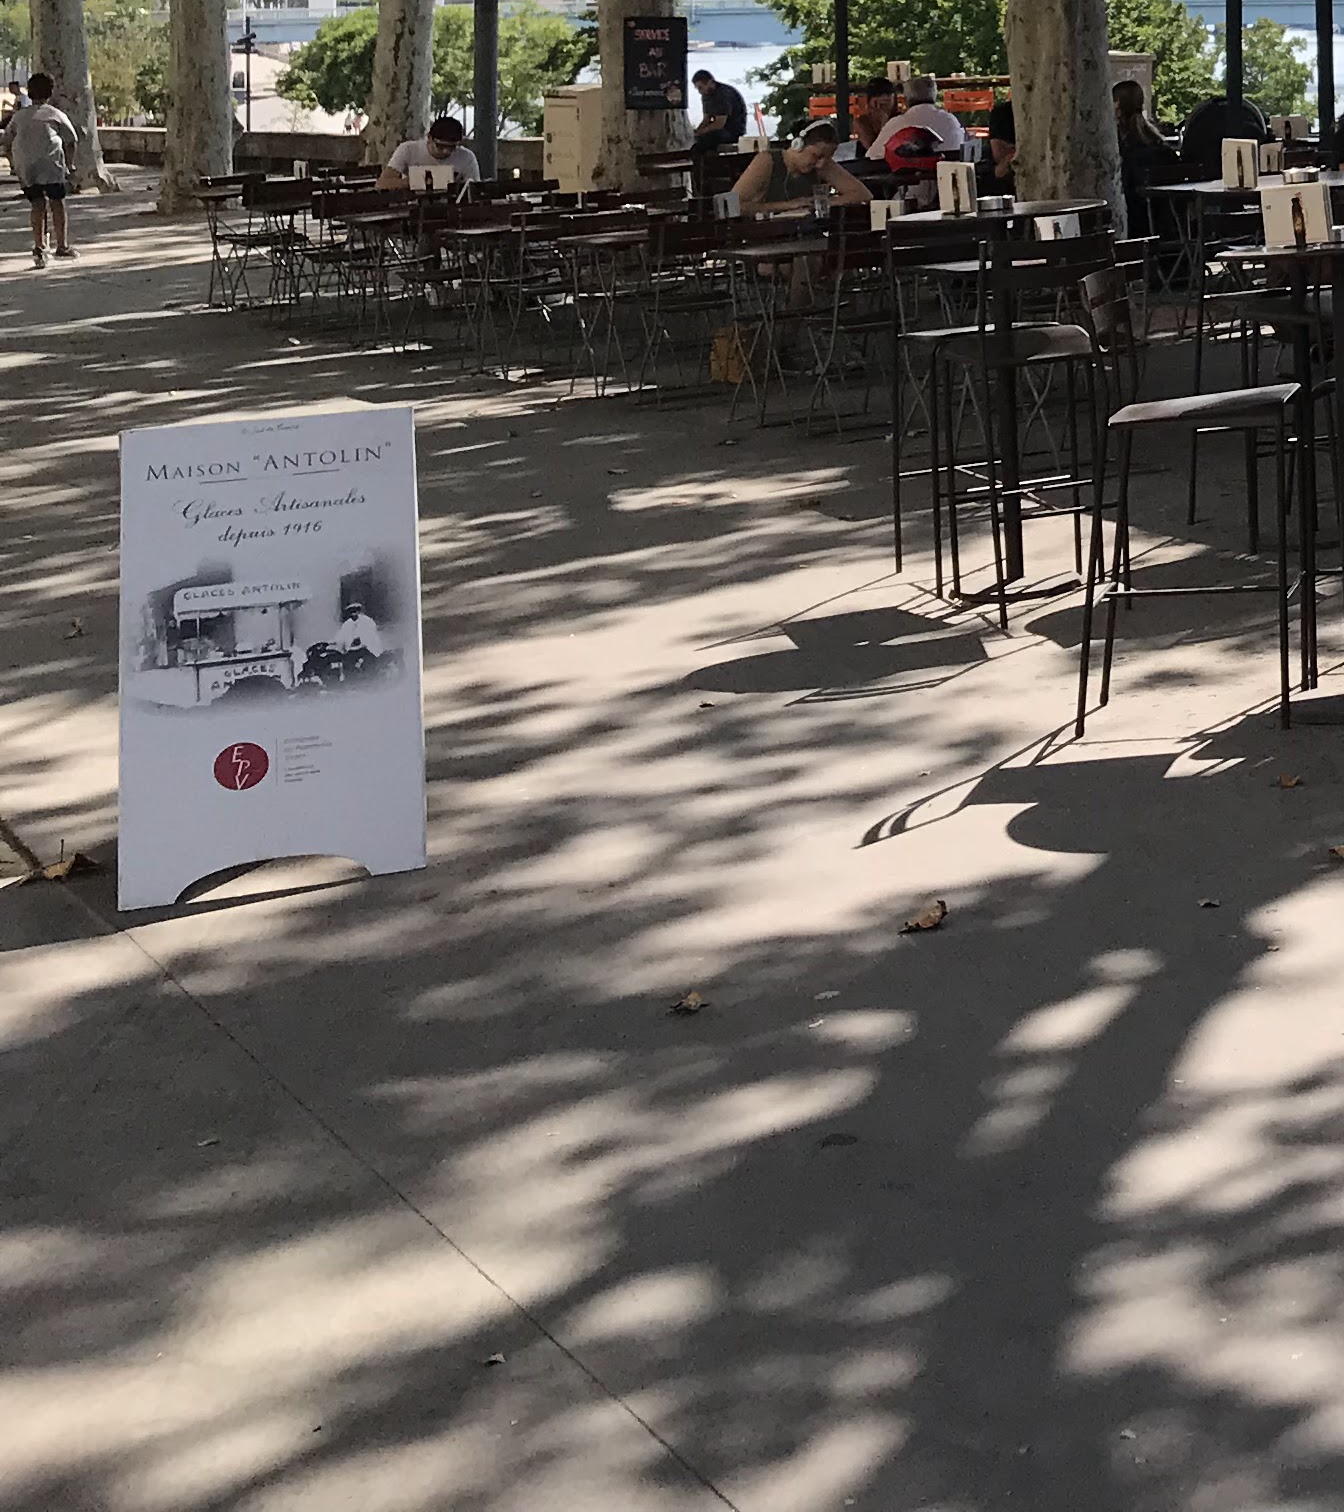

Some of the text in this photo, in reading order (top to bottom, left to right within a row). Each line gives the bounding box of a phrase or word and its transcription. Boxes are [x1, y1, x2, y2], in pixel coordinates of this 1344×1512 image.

[172, 488, 366, 529] Glaces Artisanales
[217, 525, 275, 547] depuis
[183, 582, 301, 601] GLACES ANTOLIN
